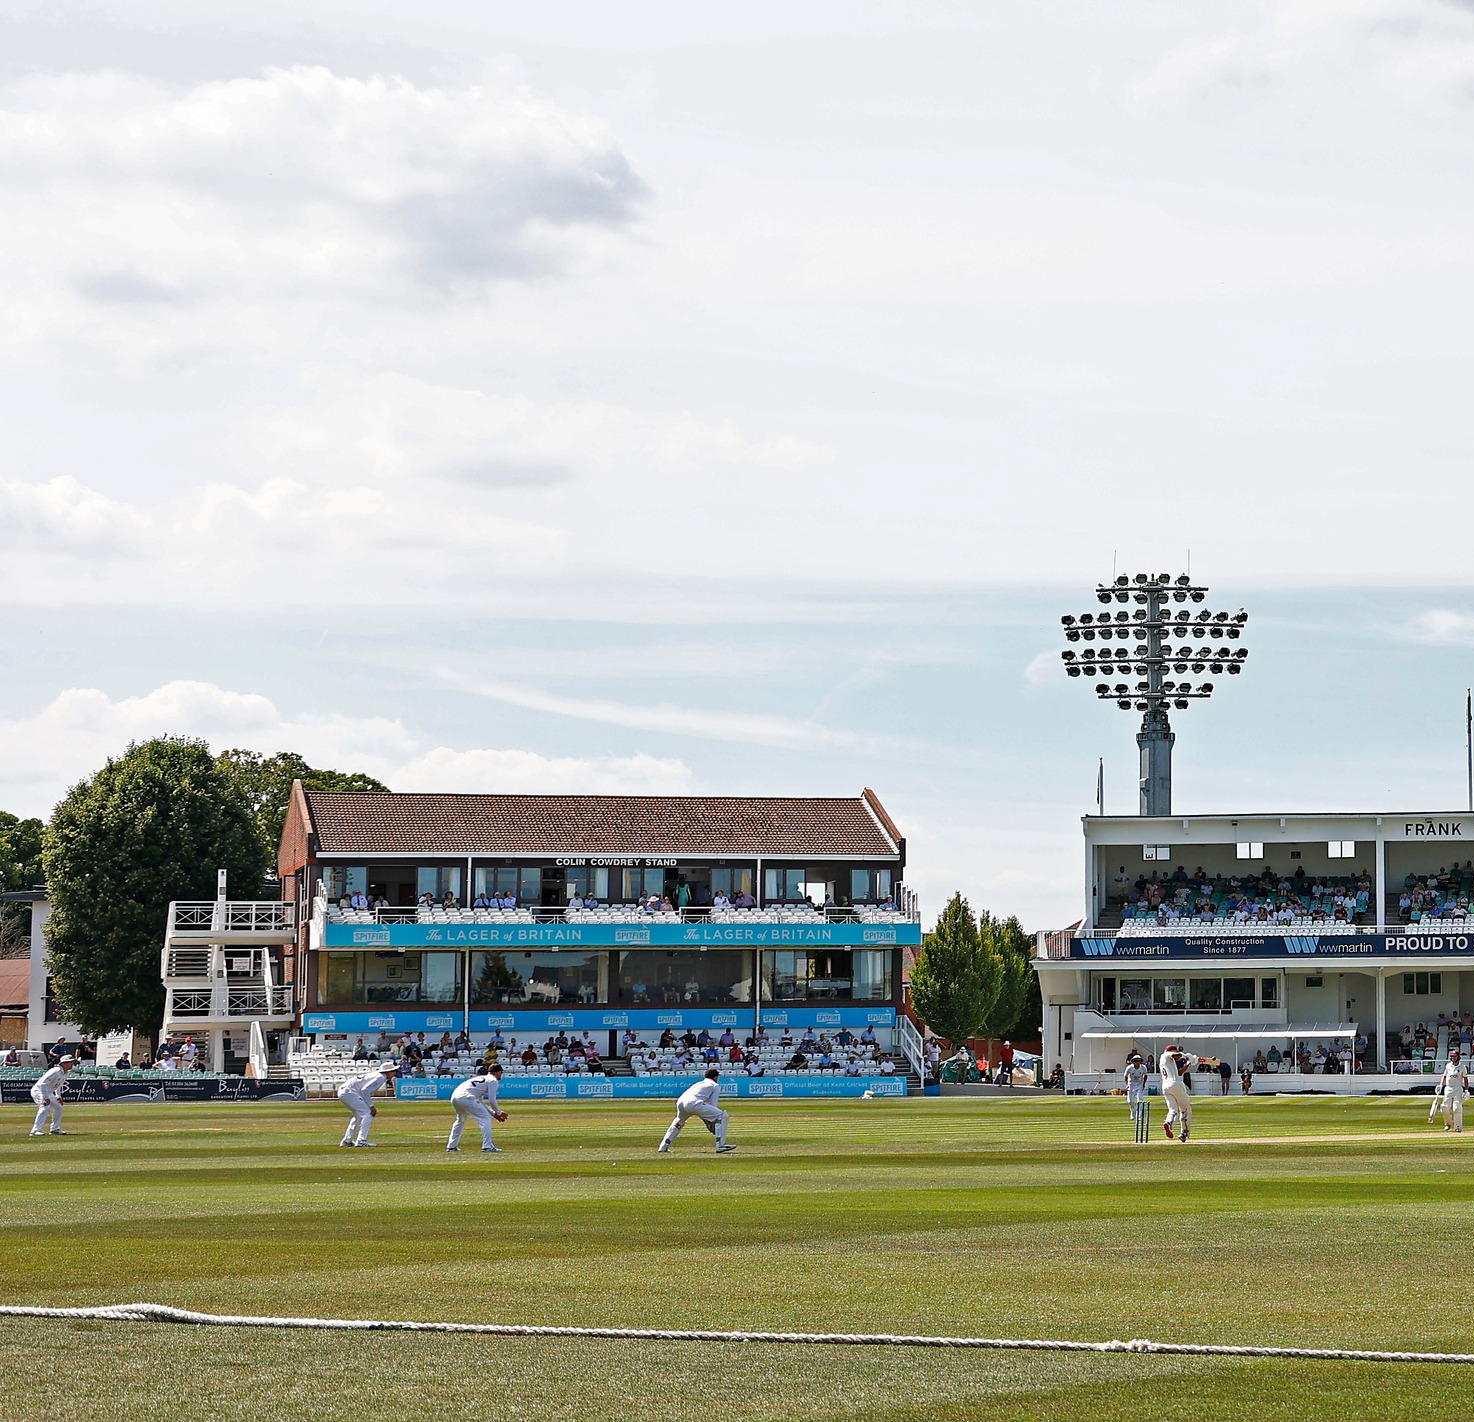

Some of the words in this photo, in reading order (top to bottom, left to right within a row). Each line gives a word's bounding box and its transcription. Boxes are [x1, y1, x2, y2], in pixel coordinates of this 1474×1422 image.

[1405, 822, 1462, 836] FRANK
[556, 858, 586, 866] COLIN
[590, 858, 641, 866] COWDREY
[645, 858, 677, 867] STAND
[354, 931, 390, 942] SPITFIRE
[425, 929, 443, 941] The
[447, 929, 499, 941] LAGER
[503, 930, 513, 941] of
[518, 929, 582, 941] BRITAIN
[615, 930, 650, 941] SPITFIRE
[683, 929, 700, 940] The
[704, 929, 754, 940] LAGER
[757, 929, 767, 941] of
[771, 929, 833, 940] BRITAIN
[863, 930, 897, 941] SPITFIRE
[1185, 938, 1214, 946] Quality
[1215, 937, 1265, 945] Construction
[1384, 936, 1444, 951] PROUD
[1447, 936, 1469, 950] TO
[1116, 944, 1170, 955] wwmartin
[1203, 946, 1225, 954] Since
[1228, 946, 1247, 954] 1877
[1319, 942, 1373, 953] wwmartin
[427, 1016, 453, 1026] SPITFIRE
[488, 1016, 515, 1026] SPITFIRE
[548, 1016, 574, 1026] SPITFIRE
[602, 1015, 628, 1026] SPITFIRE
[657, 1015, 683, 1025] SPITFIRE
[712, 1014, 737, 1024] SPITFIRE
[763, 1014, 788, 1024] SPITFIRE
[816, 1013, 841, 1023] SPITFIRE
[867, 1012, 892, 1023] SPITFIRE
[309, 1019, 336, 1028] SPITFIRE
[368, 1018, 396, 1028] SPITFIRE
[471, 1077, 486, 1088] 2
[870, 1083, 903, 1092] SPITFIRE
[401, 1085, 437, 1095] SPITFIRE
[531, 1085, 567, 1095] SPITFIRE
[578, 1084, 613, 1094] SPITFIRE
[749, 1084, 782, 1094] SPITFIRE
